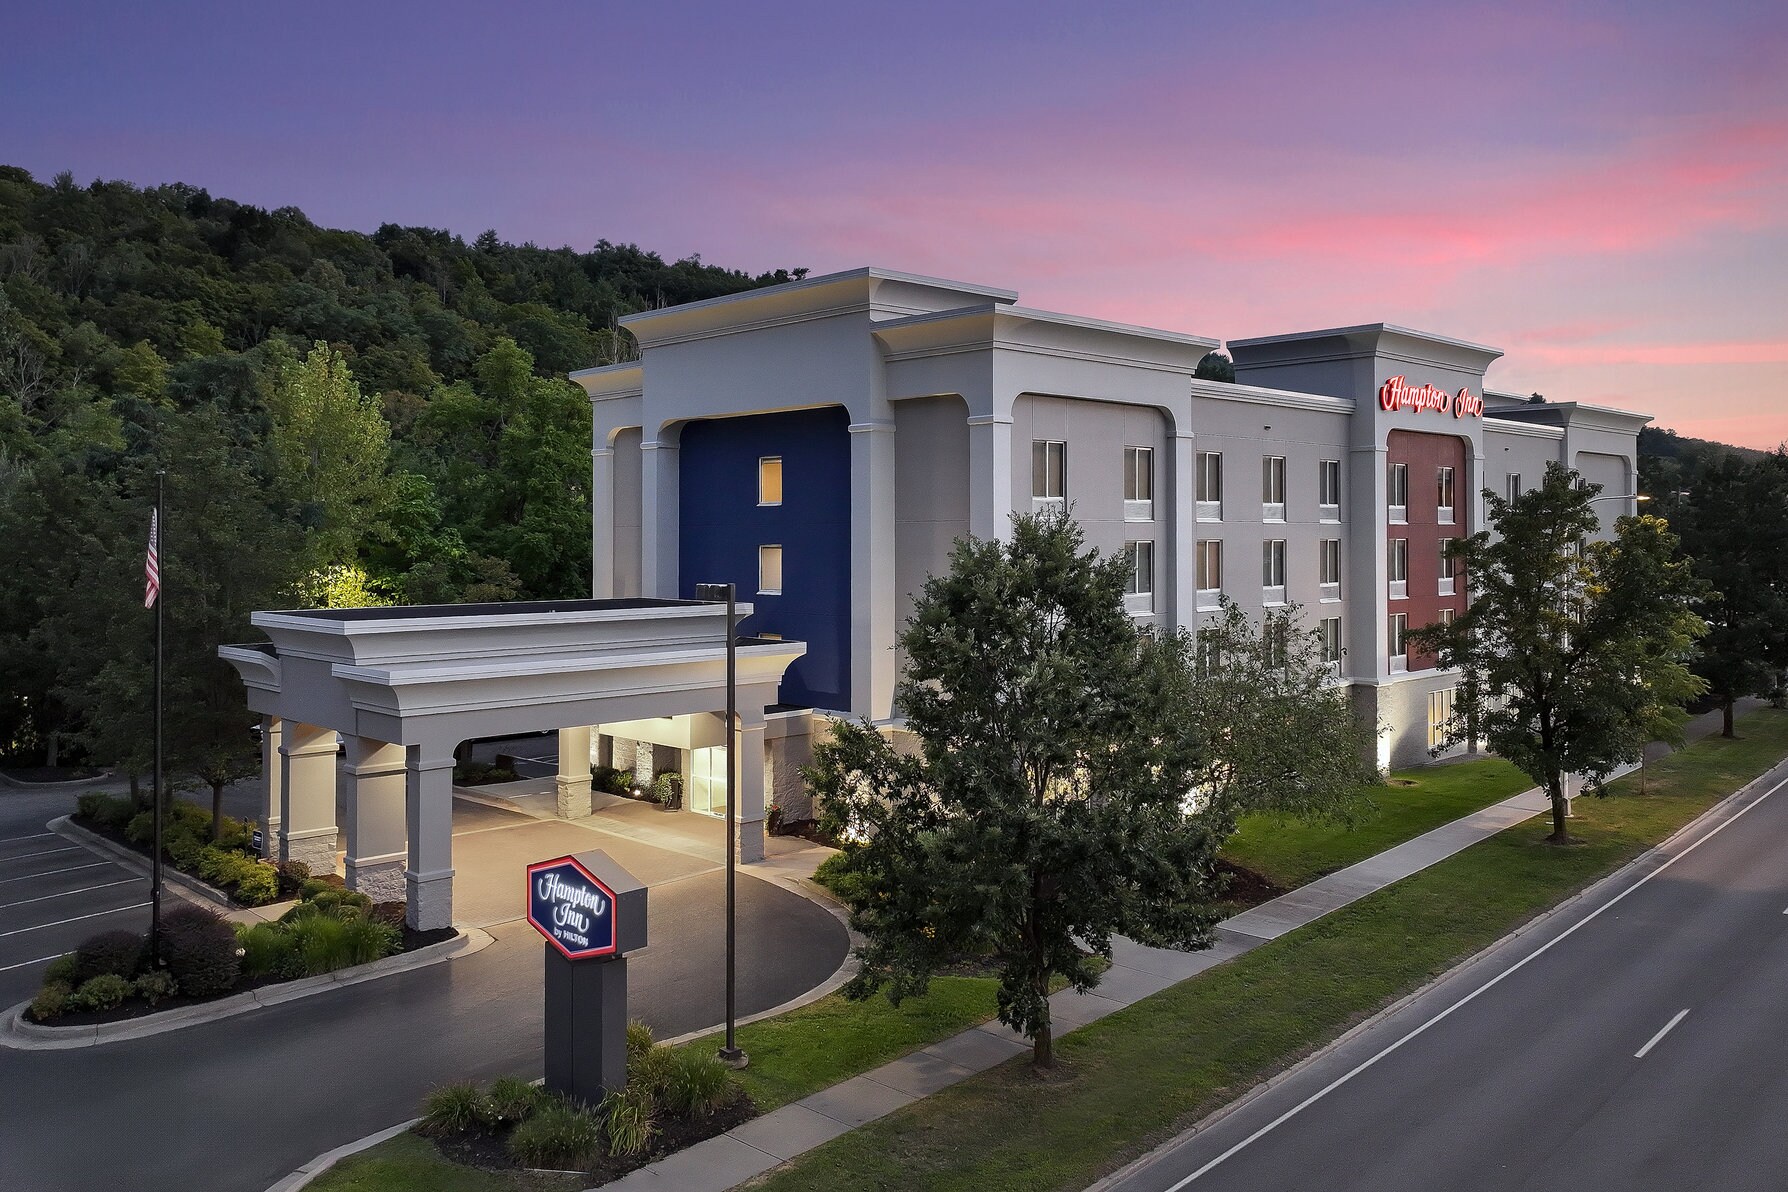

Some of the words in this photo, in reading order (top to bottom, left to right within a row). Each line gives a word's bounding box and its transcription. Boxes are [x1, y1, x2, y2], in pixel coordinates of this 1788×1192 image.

[1379, 375, 1450, 413] Hampton
[1453, 388, 1484, 418] Inn
[538, 873, 605, 915] Hampton
[554, 903, 590, 932] Inn
[553, 927, 563, 939] by
[563, 930, 589, 947] HILTON
